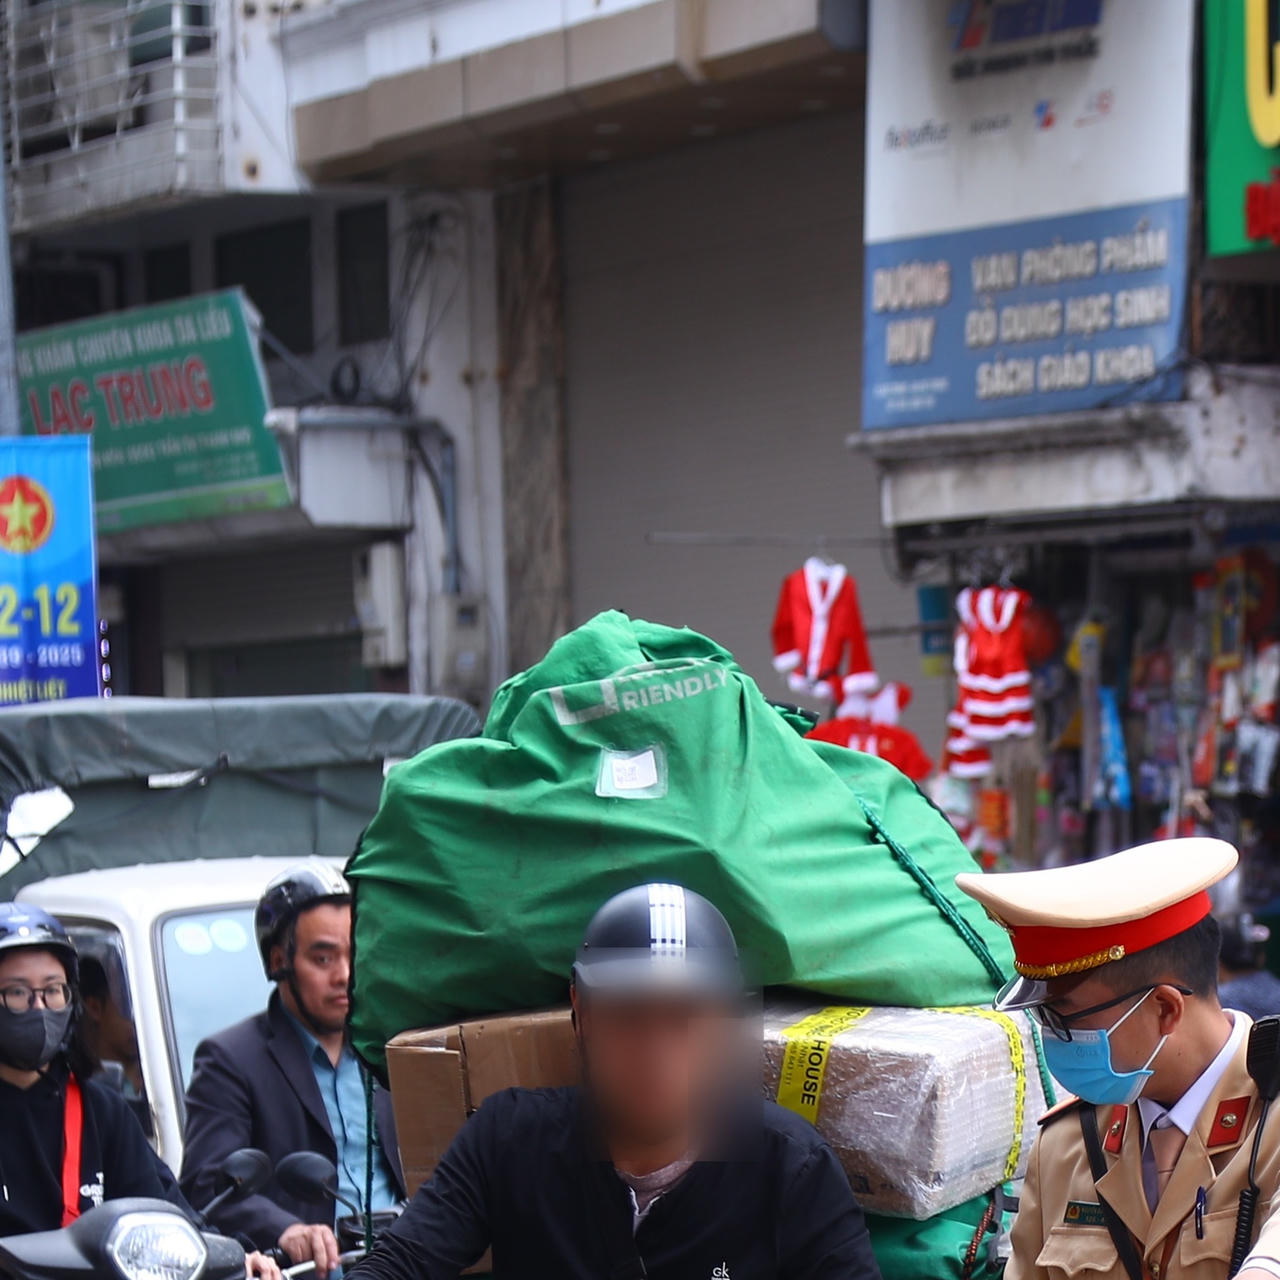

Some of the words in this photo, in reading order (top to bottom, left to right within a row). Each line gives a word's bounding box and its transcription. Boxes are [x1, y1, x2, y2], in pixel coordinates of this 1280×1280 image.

[96, 354, 214, 428] TRUNG
[622, 667, 729, 711] RIENDLY
[801, 1040, 827, 1106] HOUSE
